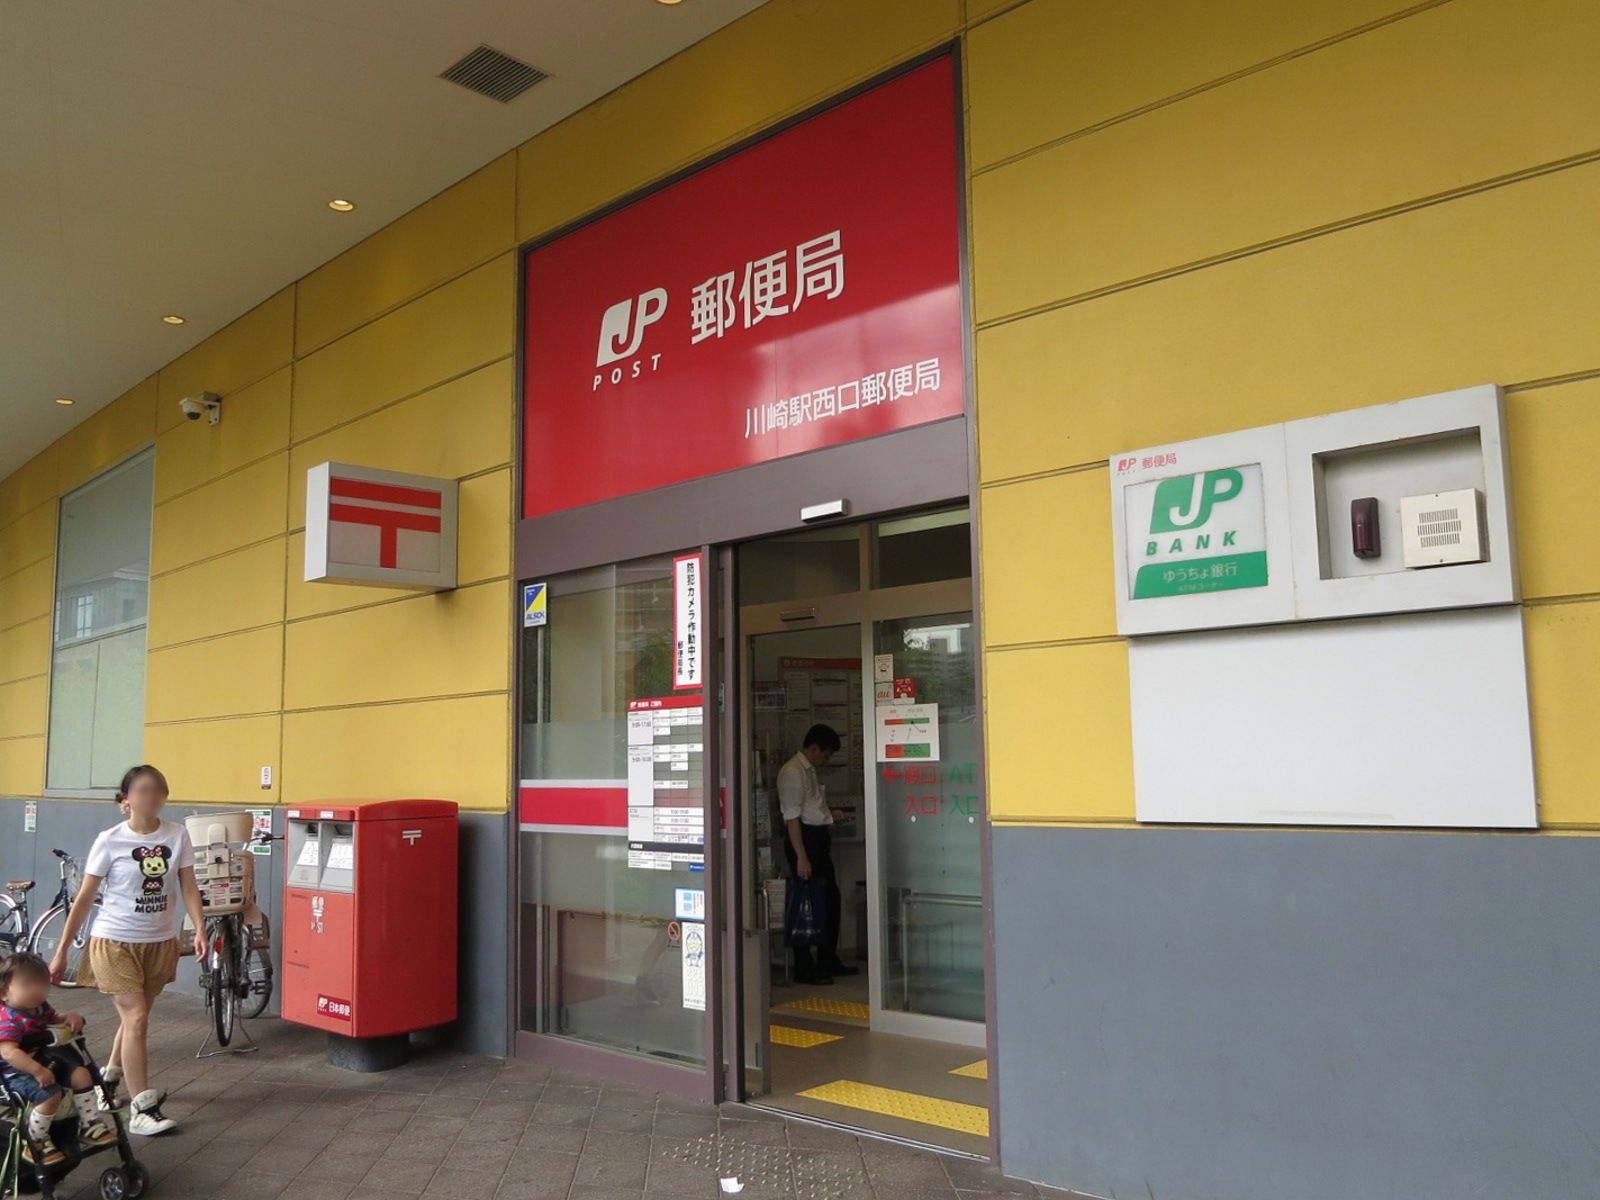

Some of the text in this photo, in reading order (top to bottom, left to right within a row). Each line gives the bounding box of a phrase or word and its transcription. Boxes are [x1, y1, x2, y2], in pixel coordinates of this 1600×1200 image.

[690, 229, 845, 346] 郵便局
[592, 353, 662, 391] POST
[744, 357, 941, 439] 川崎駅西口郵便局
[1149, 468, 1244, 534] JP
[1146, 530, 1238, 556] BANK
[1163, 562, 1238, 583] ゆうちょ銀行
[904, 794, 937, 816] 入口
[134, 903, 168, 913] MOUSE
[135, 894, 168, 905] MINNIE
